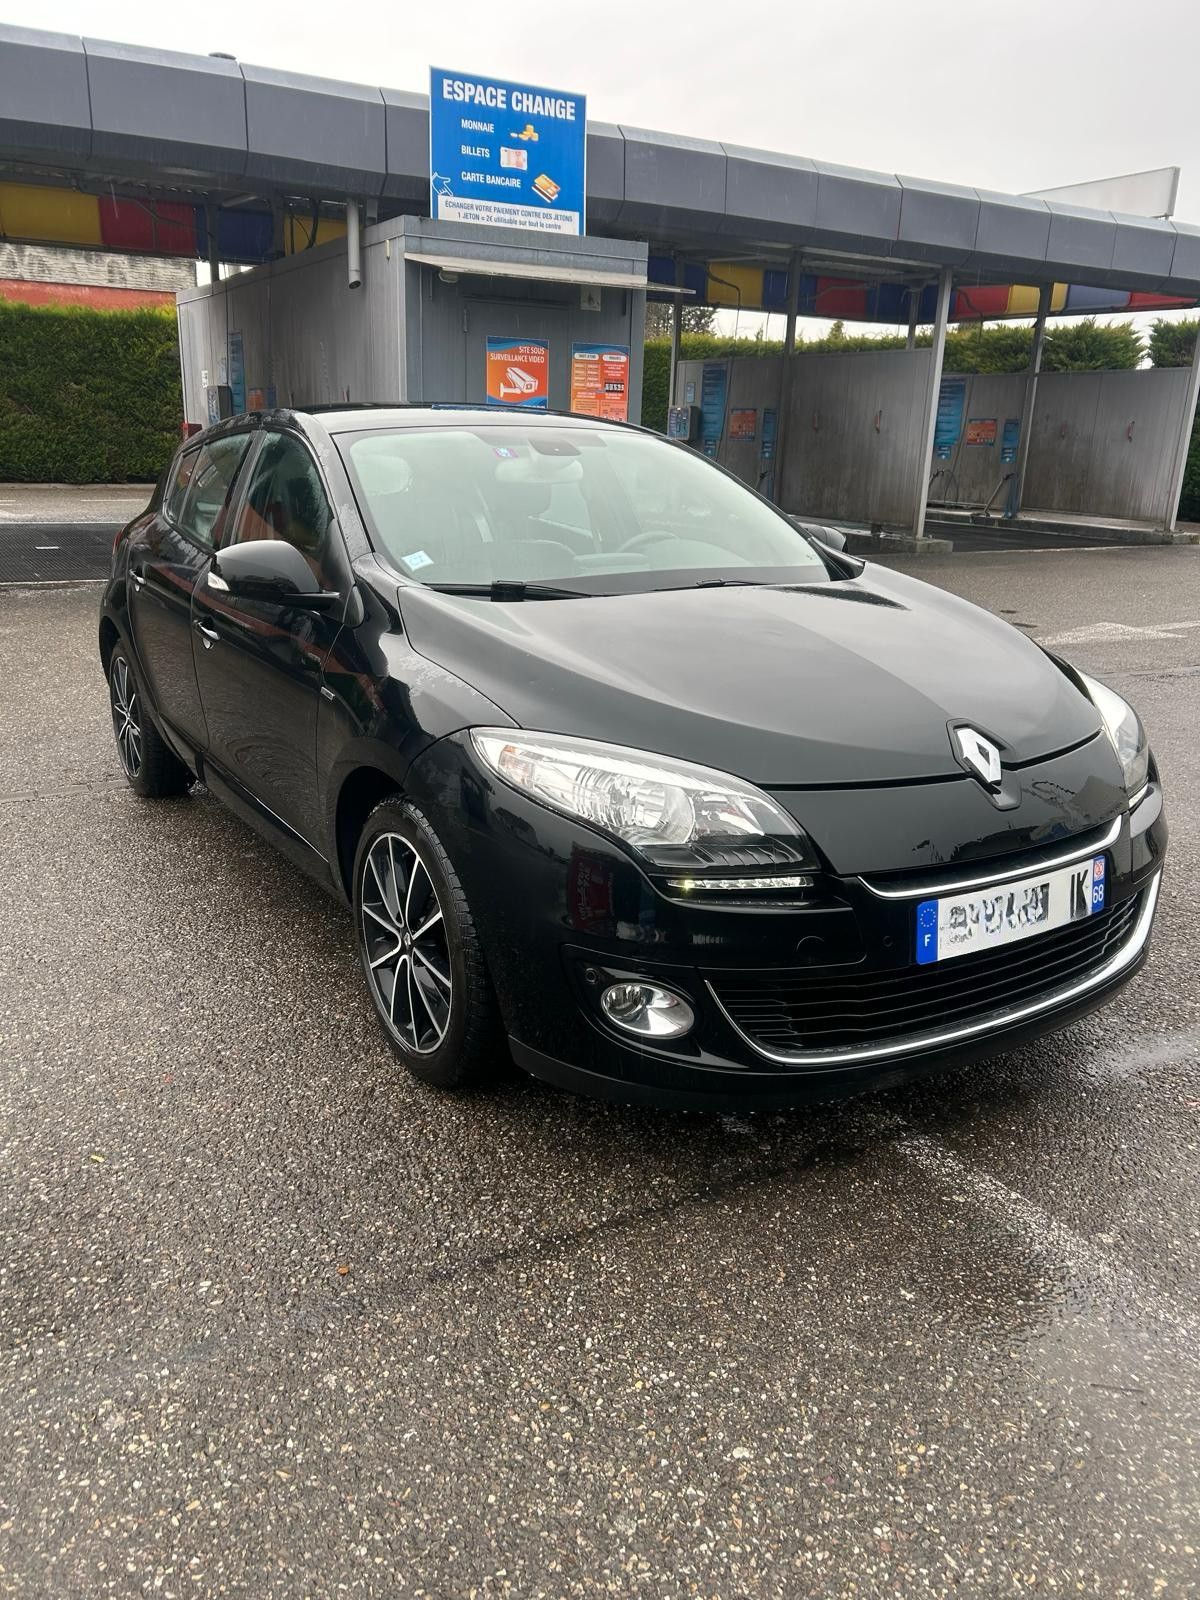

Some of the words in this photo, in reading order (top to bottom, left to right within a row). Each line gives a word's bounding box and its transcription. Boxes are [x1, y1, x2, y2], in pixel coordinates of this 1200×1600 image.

[442, 78, 507, 109] ESPACE
[511, 91, 576, 121] CHANGE
[461, 118, 495, 133] MONNAIE
[461, 145, 490, 158] BILLETS
[461, 171, 484, 183] CARTE
[486, 174, 521, 188] BANCAIRE
[475, 203, 492, 213] VOTRE
[493, 206, 520, 216] PAIEMENT
[521, 209, 542, 219] CONTRE
[542, 212, 553, 220] DES
[554, 213, 573, 222] JETONS
[463, 212, 480, 221] JETON
[494, 215, 518, 225] utilisable
[519, 219, 527, 227] sur
[528, 219, 539, 228] tout
[539, 220, 545, 228] le
[545, 221, 561, 230] centre
[490, 352, 528, 363] SURVEILLANCE
[519, 346, 530, 354] SITE
[530, 347, 545, 355] SOUS
[1092, 884, 1105, 903] 68
[923, 934, 932, 947] F
